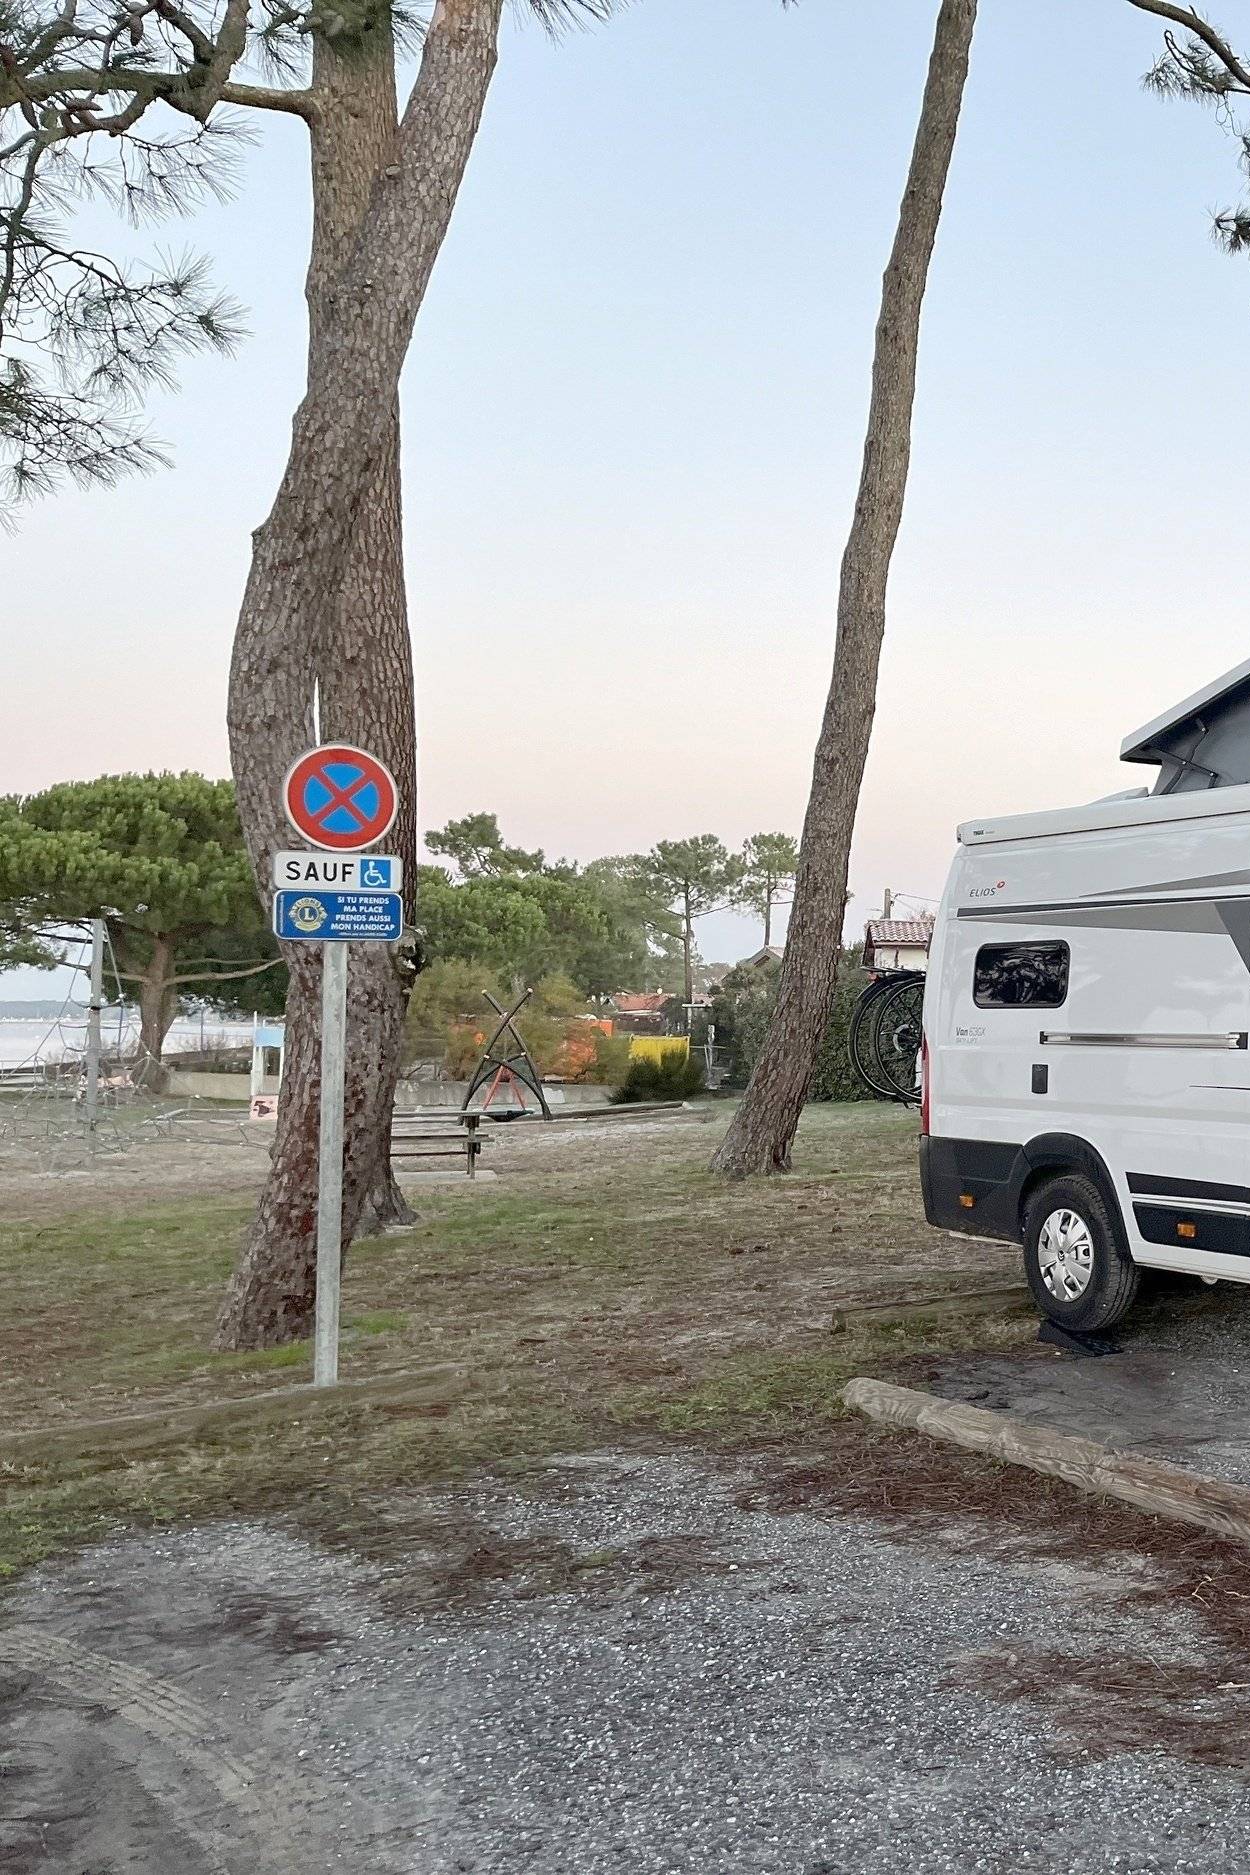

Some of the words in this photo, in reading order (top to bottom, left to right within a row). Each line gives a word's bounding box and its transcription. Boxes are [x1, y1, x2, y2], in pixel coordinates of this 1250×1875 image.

[286, 861, 354, 882] SAUF
[969, 887, 997, 898] ELIOS
[346, 896, 357, 904] TU
[358, 896, 390, 905] PRENDS
[303, 907, 314, 921] L
[343, 905, 357, 913] MA
[359, 905, 383, 913] PLACE
[335, 914, 366, 922] PRENDS
[330, 923, 351, 931] MON
[353, 923, 395, 932] HANDICAP
[955, 1026, 969, 1037] Van
